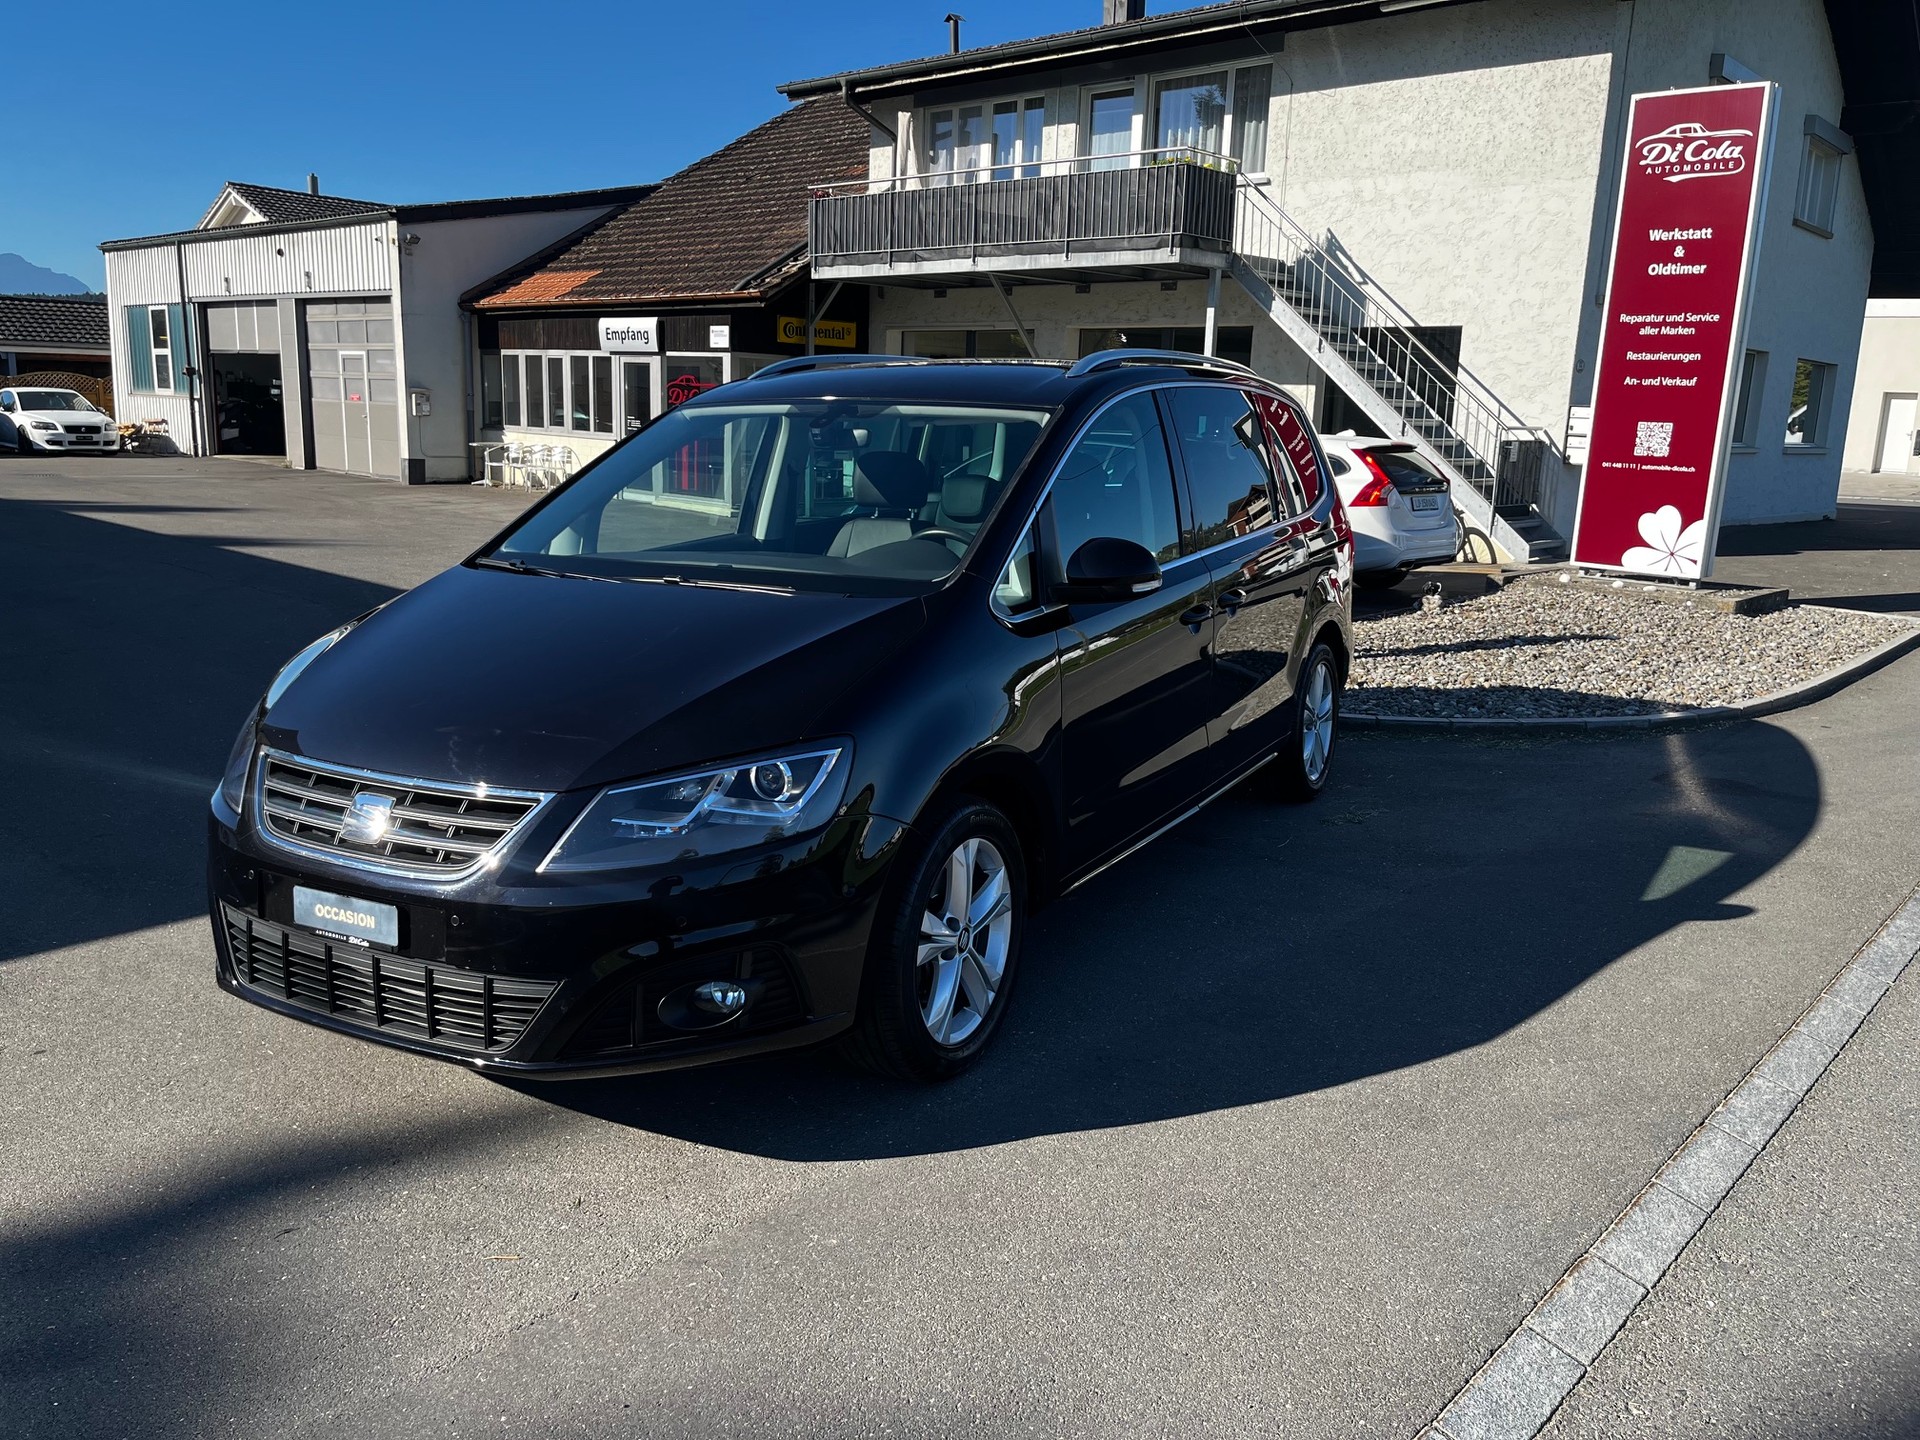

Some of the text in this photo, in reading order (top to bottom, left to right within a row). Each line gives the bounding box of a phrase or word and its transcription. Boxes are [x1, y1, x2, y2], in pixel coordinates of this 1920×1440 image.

[1645, 161, 1735, 175] AUTOMOBILE
[1648, 227, 1713, 242] Werkstatt
[1673, 245, 1686, 258] &
[1647, 262, 1708, 276] Oldtimer
[1619, 312, 1721, 325] Reparatur und Service
[605, 326, 650, 345] Empfang
[1638, 325, 1696, 336] aller Marken
[1626, 350, 1702, 364] Restaurierungen
[1623, 376, 1698, 387] An- und Verkauf
[1641, 464, 1696, 473] automobile-dicola.ch
[314, 903, 375, 929] OCCASION
